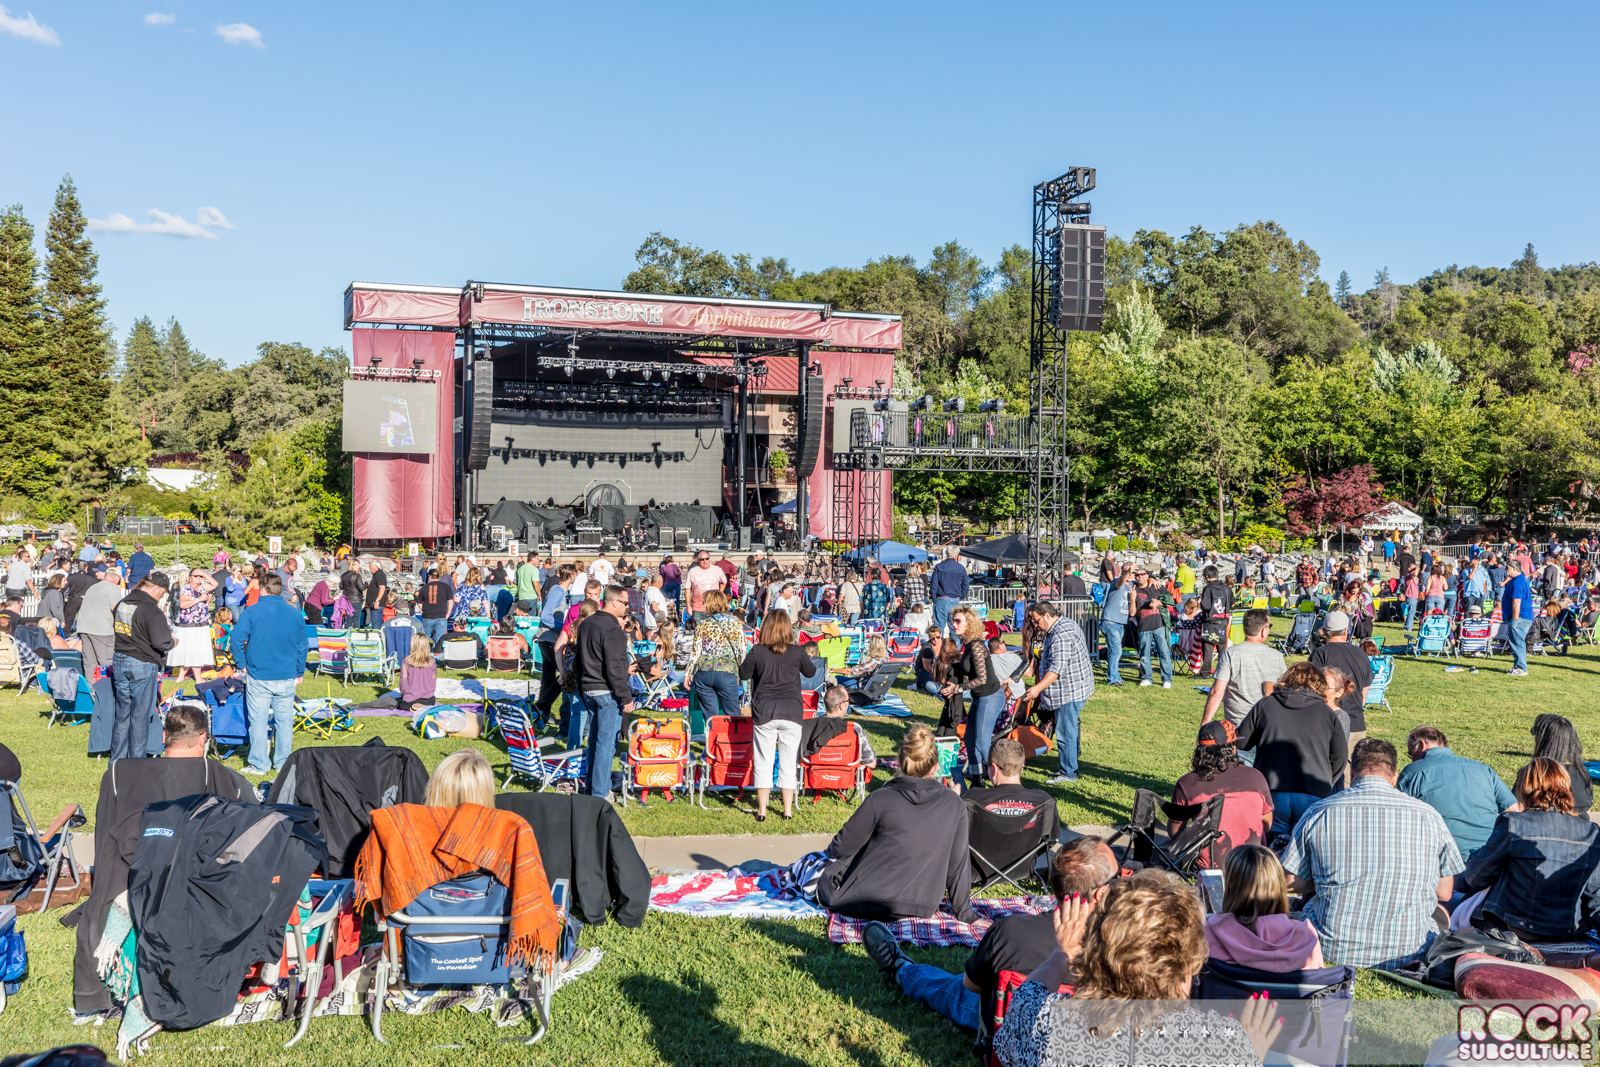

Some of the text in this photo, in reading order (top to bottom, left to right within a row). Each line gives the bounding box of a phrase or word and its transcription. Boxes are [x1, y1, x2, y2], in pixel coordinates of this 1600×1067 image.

[521, 296, 790, 331] IRONSTONE Amphitheatre
[272, 541, 279, 552] D
[410, 546, 416, 555] A
[510, 545, 516, 555] E
[553, 547, 558, 555] B
[443, 957, 468, 965] Coolest
[468, 956, 483, 964] Spot
